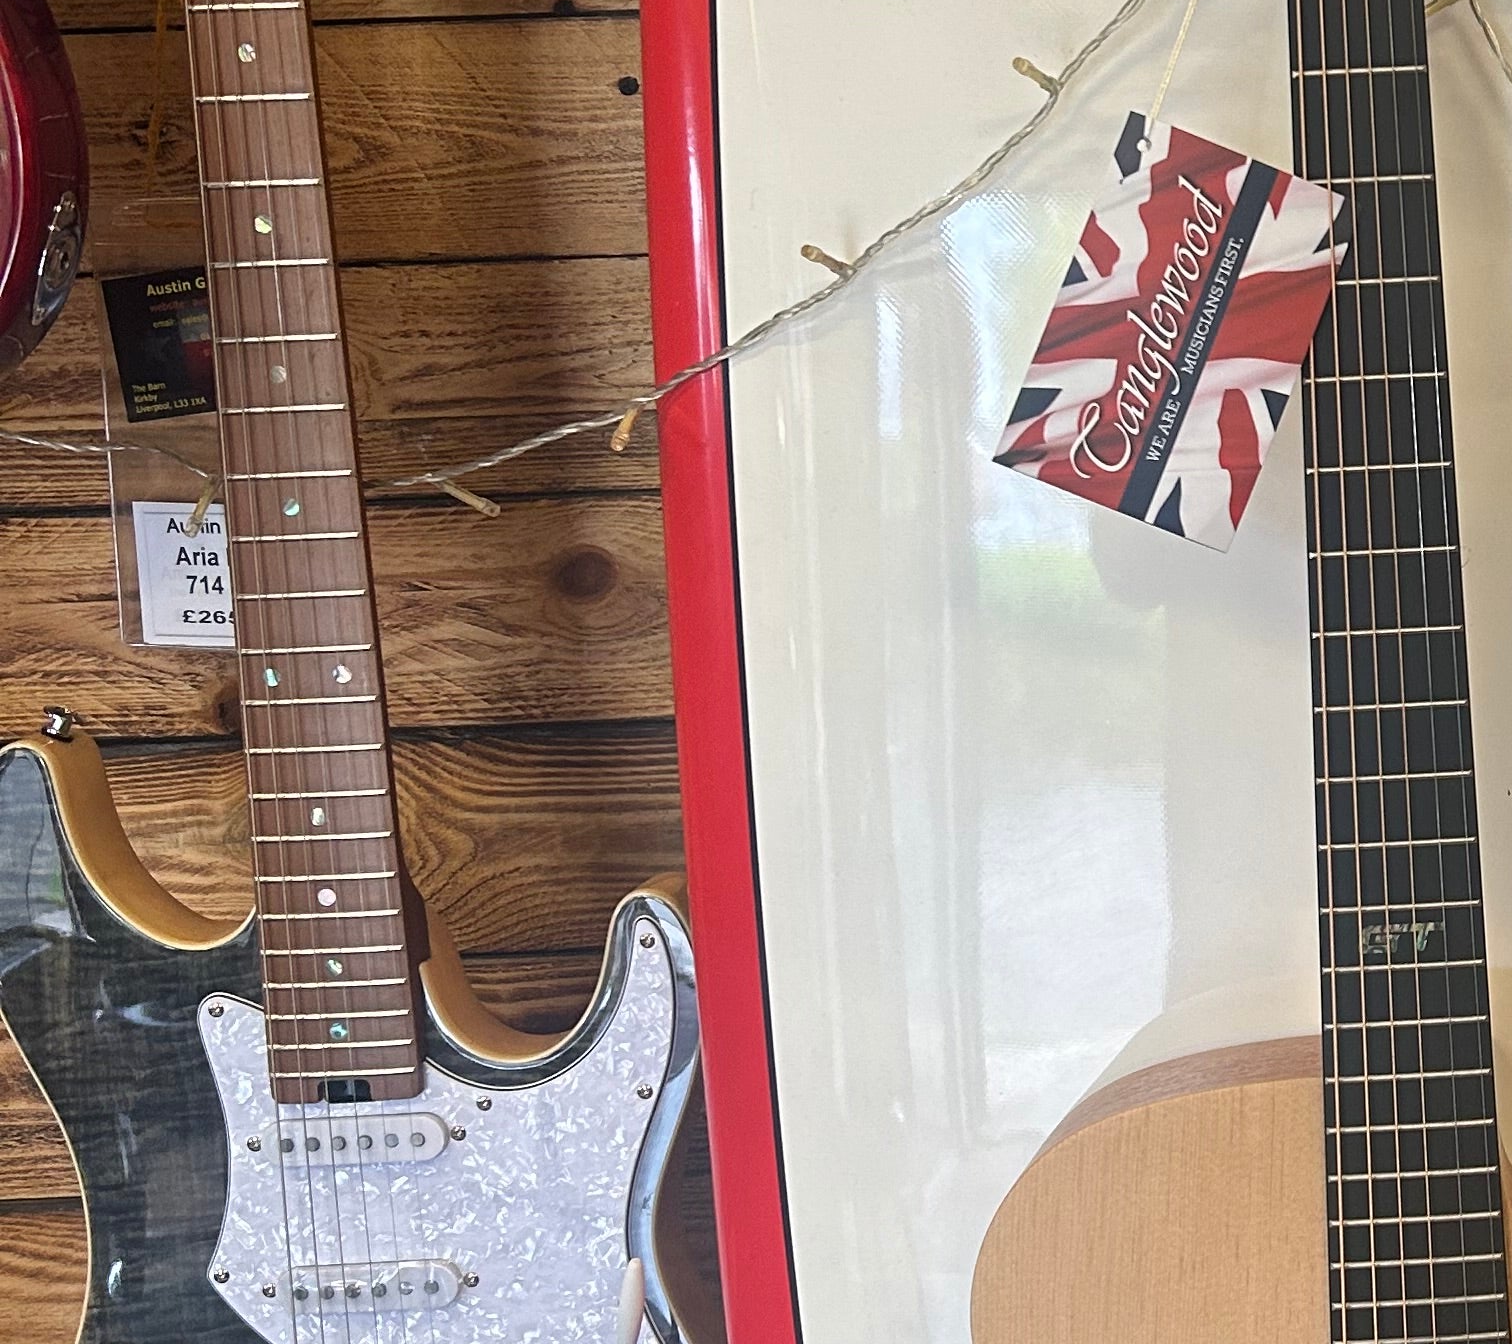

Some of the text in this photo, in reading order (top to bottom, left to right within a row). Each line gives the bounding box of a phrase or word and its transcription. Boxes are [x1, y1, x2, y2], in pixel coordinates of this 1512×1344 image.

[147, 280, 192, 297] Austin
[1069, 175, 1225, 479] Tanglewood
[1146, 435, 1166, 462] WE
[1158, 399, 1181, 437] ARE
[1181, 283, 1224, 376] MUSICIANS
[176, 547, 219, 566] Aria
[186, 575, 224, 594] 714
[1362, 922, 1444, 954] GT
